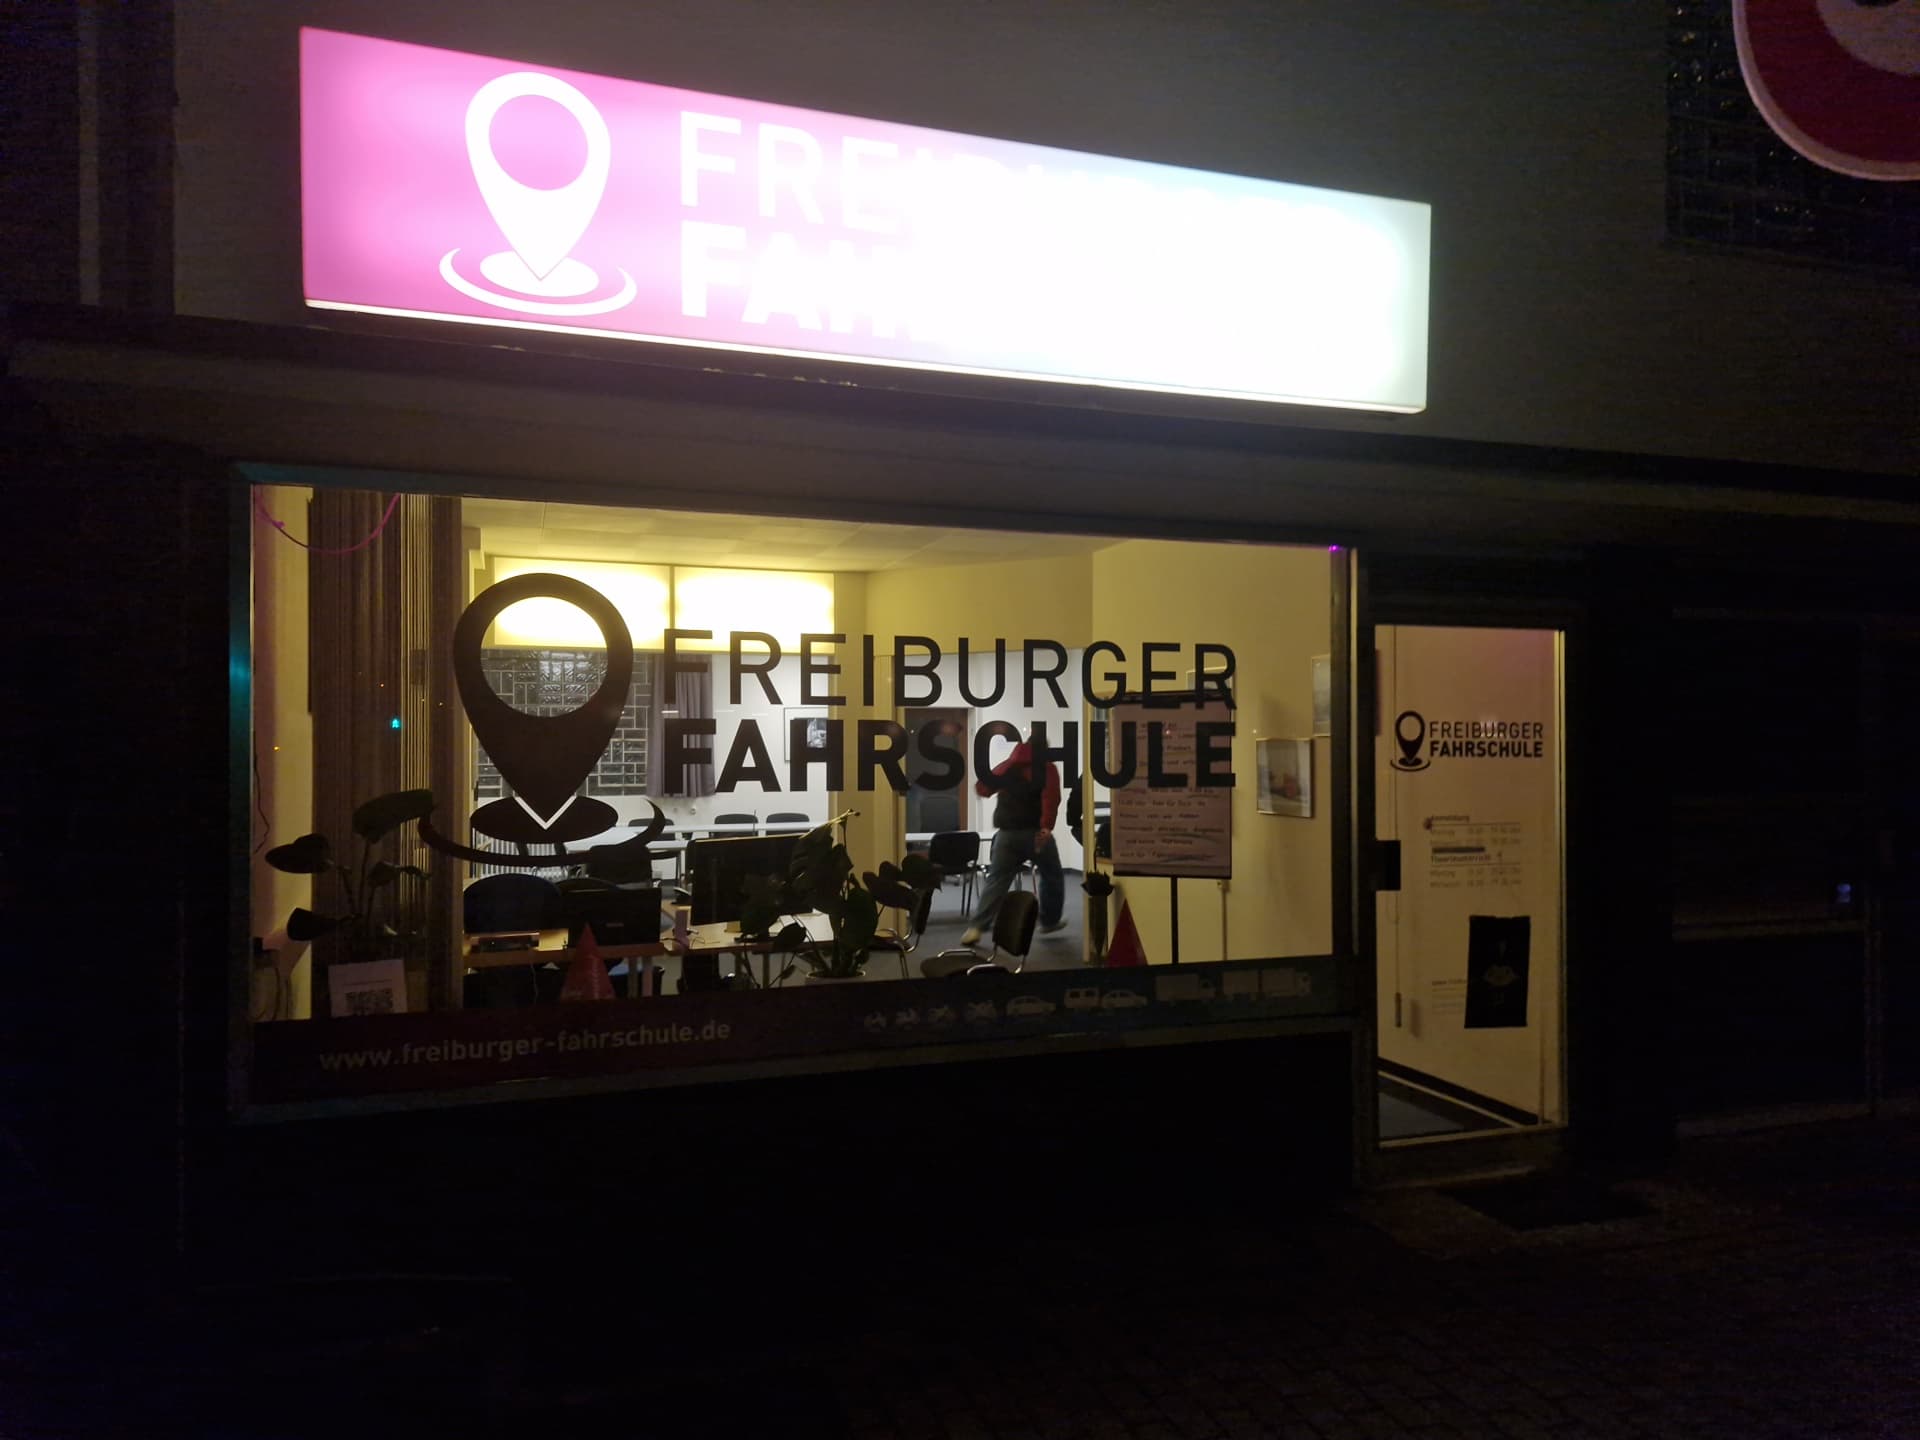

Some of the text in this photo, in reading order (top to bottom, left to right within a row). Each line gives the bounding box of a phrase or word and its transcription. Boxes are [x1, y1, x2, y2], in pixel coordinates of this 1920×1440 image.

[664, 628, 1237, 709] FREIBURGER
[663, 717, 1237, 795] FAHRSCHULE
[1429, 721, 1544, 740] FREIBURGER
[1429, 740, 1544, 758] FAHRSCHULE
[318, 1018, 732, 1073] www.freiburger-fahrschule.de
